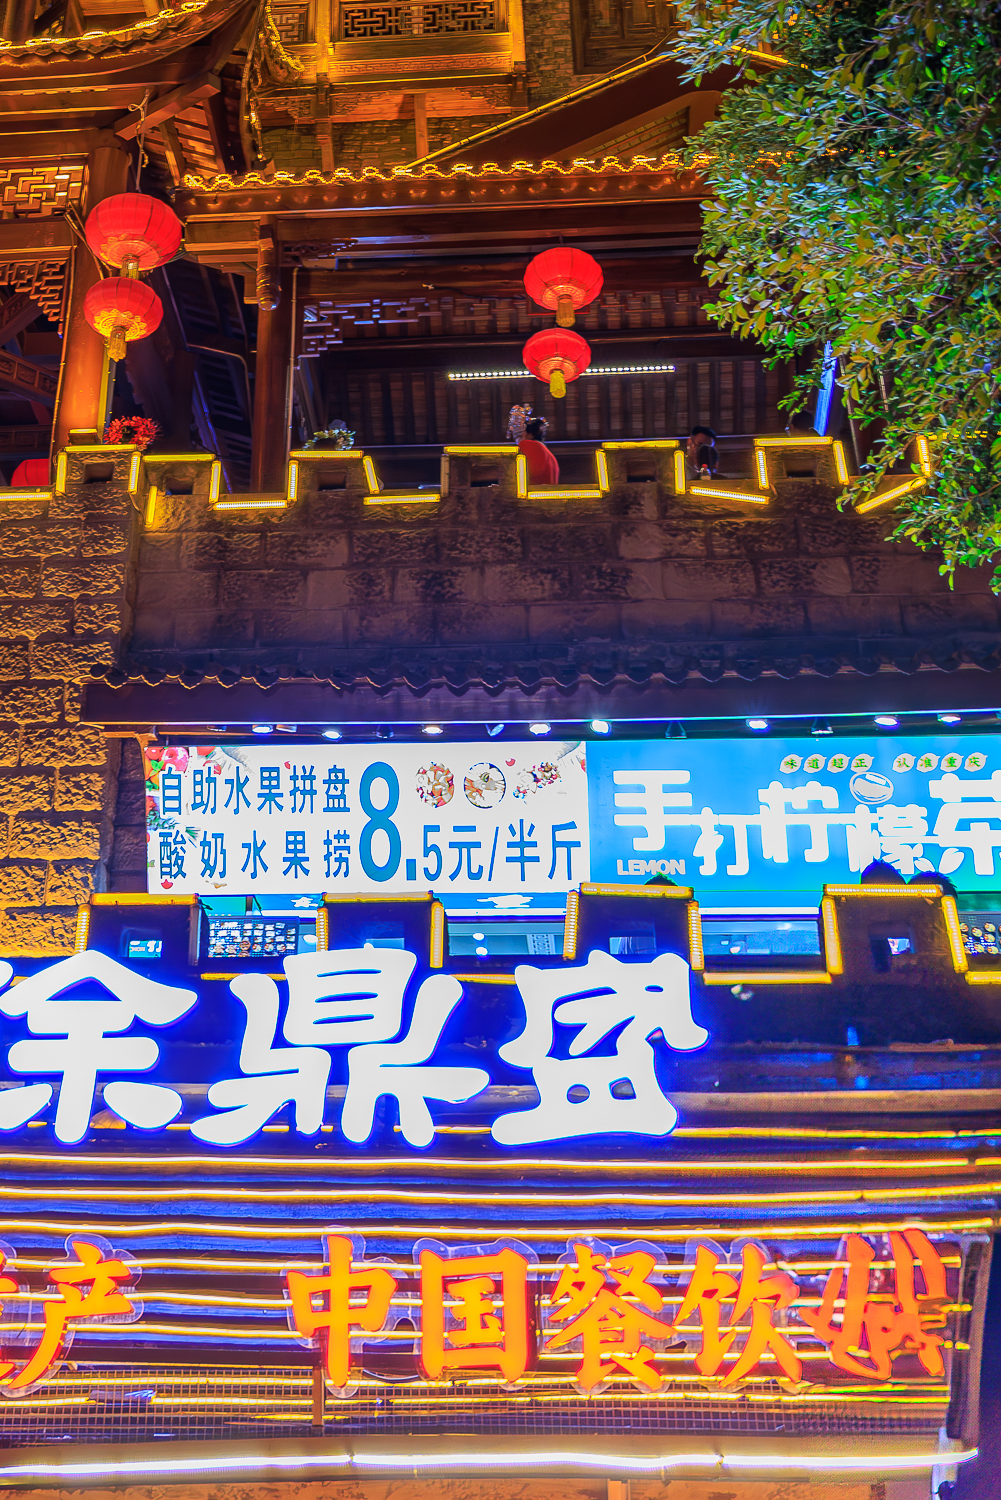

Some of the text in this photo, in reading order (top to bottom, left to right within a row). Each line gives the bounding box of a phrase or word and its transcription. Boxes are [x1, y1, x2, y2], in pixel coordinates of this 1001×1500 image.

[784, 756, 868, 770] 味道超正
[896, 756, 981, 769] 认准重庆
[159, 764, 351, 817] 自助水果拼盘
[159, 828, 352, 881] 酸奶水果捞
[616, 858, 686, 876] LEMON
